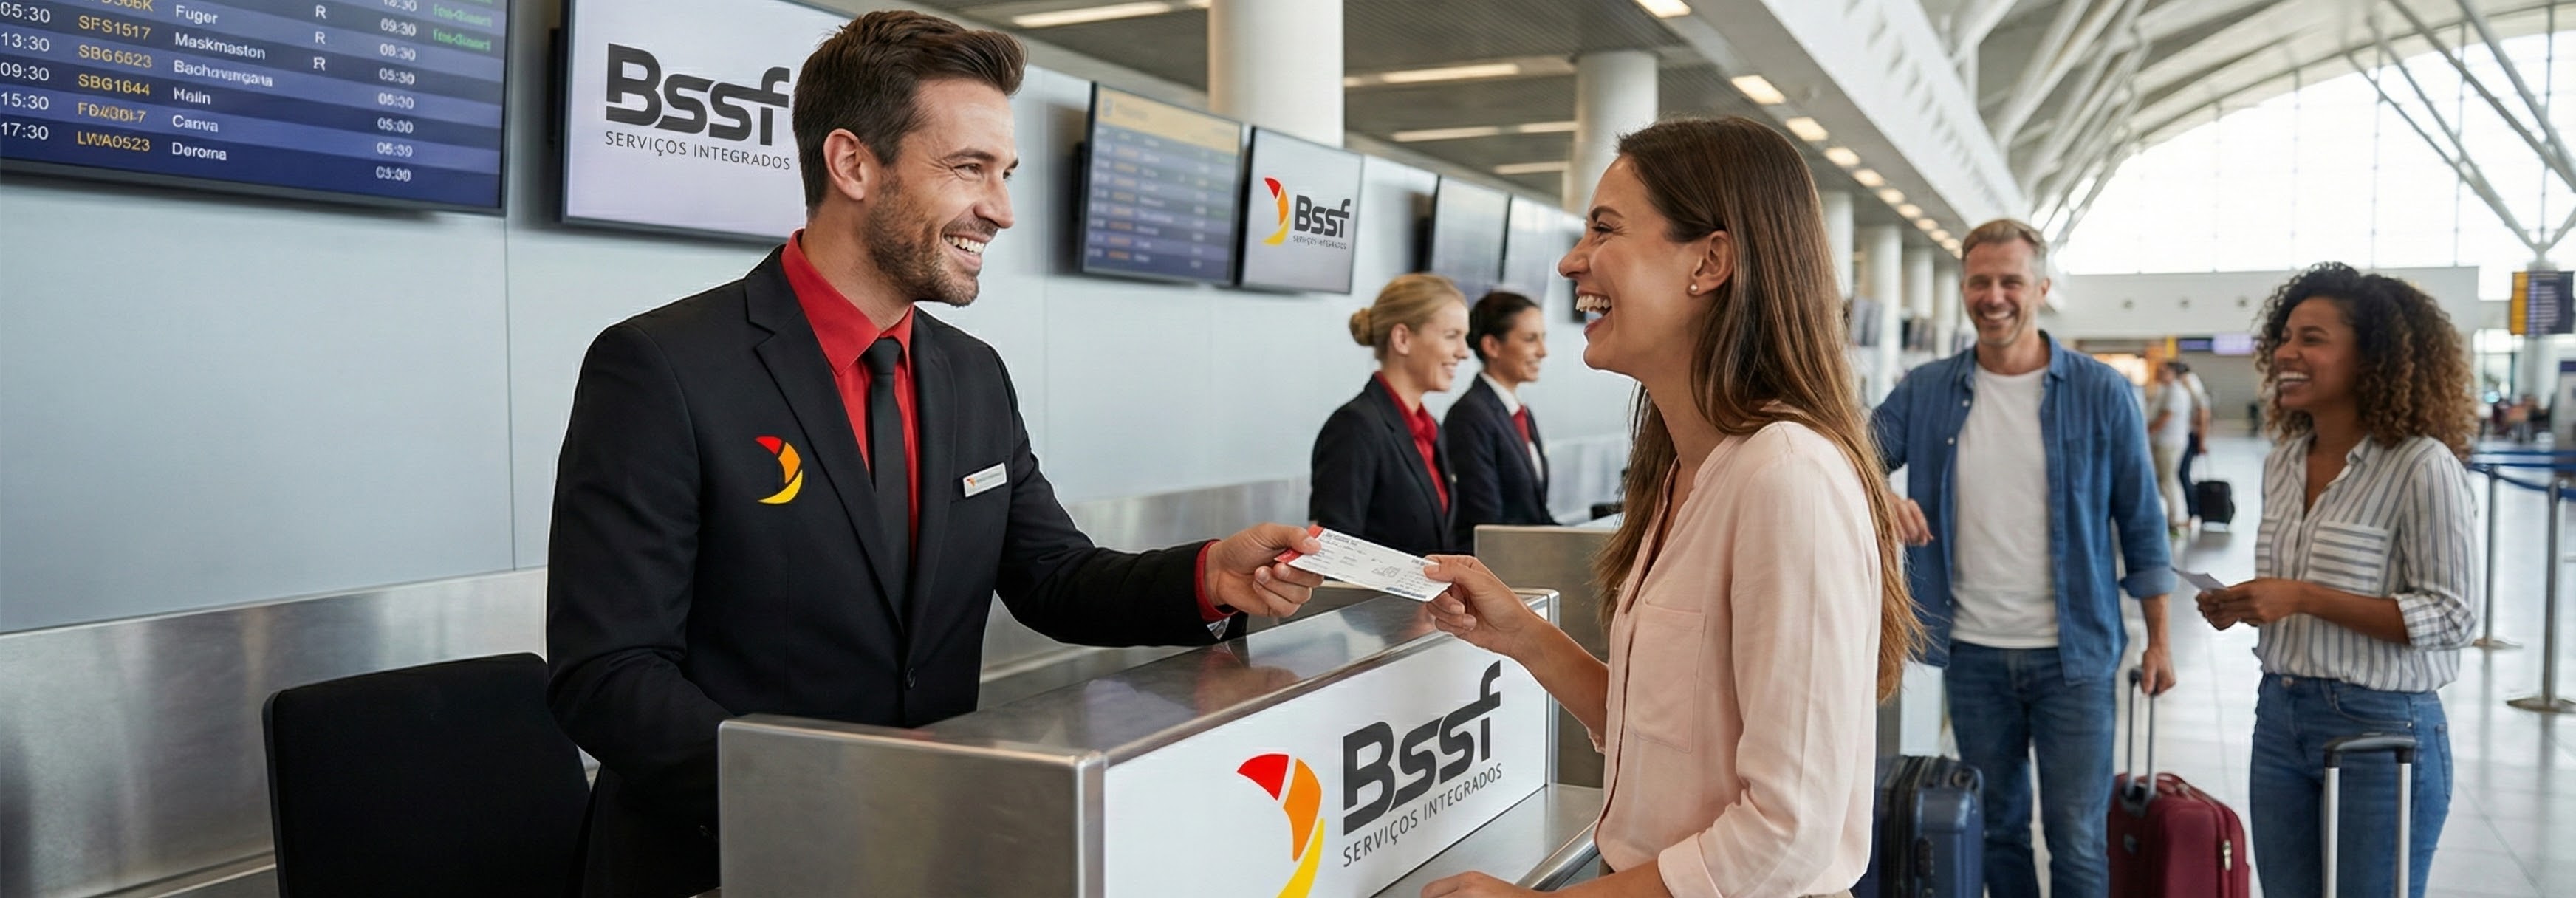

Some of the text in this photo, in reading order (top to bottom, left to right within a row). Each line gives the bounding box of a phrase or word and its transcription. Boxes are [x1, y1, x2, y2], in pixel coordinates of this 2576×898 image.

[315, 5, 326, 19] R
[1, 2, 50, 23] 05:30
[78, 15, 151, 40] SFS1517
[313, 56, 326, 71] R
[1, 32, 49, 52] 13:30
[315, 31, 326, 44] R
[1, 62, 49, 81] 09:30
[1, 92, 49, 110] 15:30
[606, 43, 790, 146] Bssf
[1, 122, 49, 140] 17:30
[606, 131, 790, 170] SERVIÇOS INTEGRADOS
[1294, 194, 1351, 239] Bssf
[1343, 659, 1501, 836] Bssf
[1343, 763, 1502, 868] SERVIÇOS INTEGRADOS
